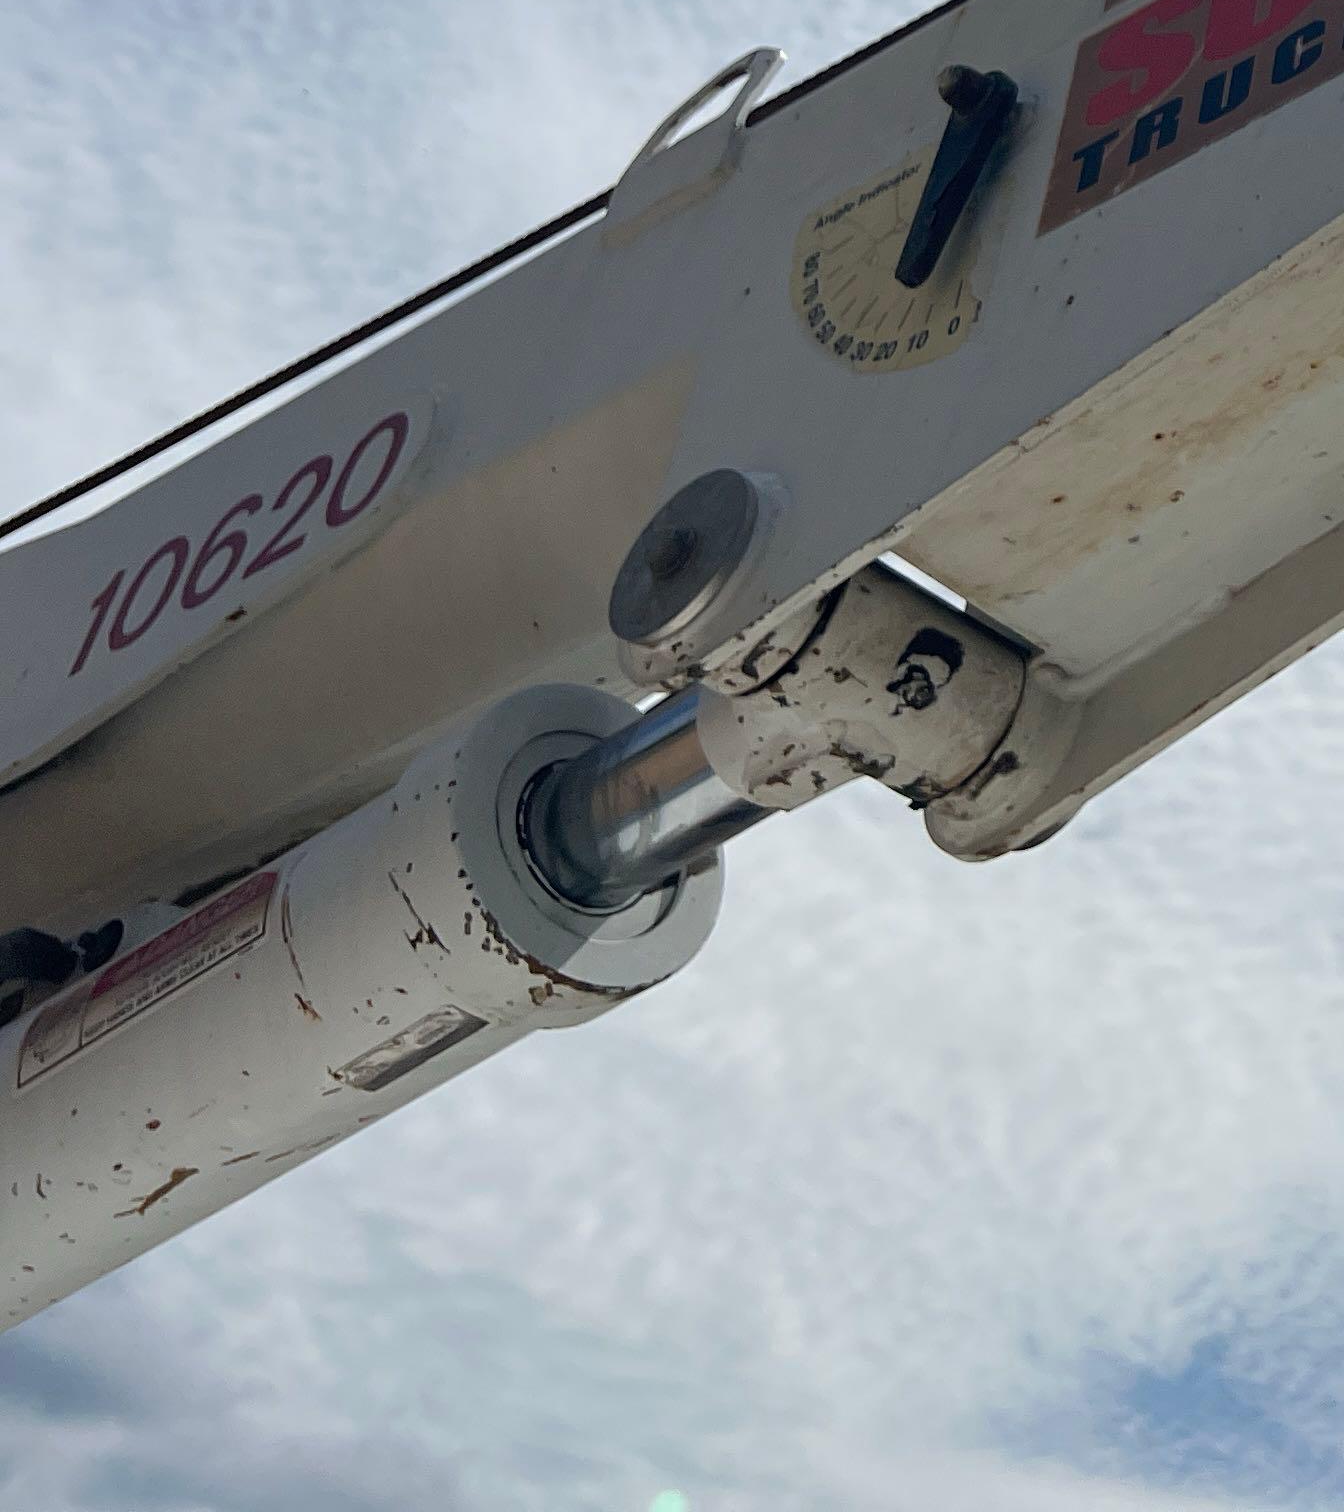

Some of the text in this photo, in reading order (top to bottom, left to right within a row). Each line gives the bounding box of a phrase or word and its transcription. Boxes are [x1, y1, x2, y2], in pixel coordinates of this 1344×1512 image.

[872, 340, 898, 362] 20
[907, 329, 929, 353] 10
[947, 315, 960, 336] 0
[68, 411, 410, 678] 10620
